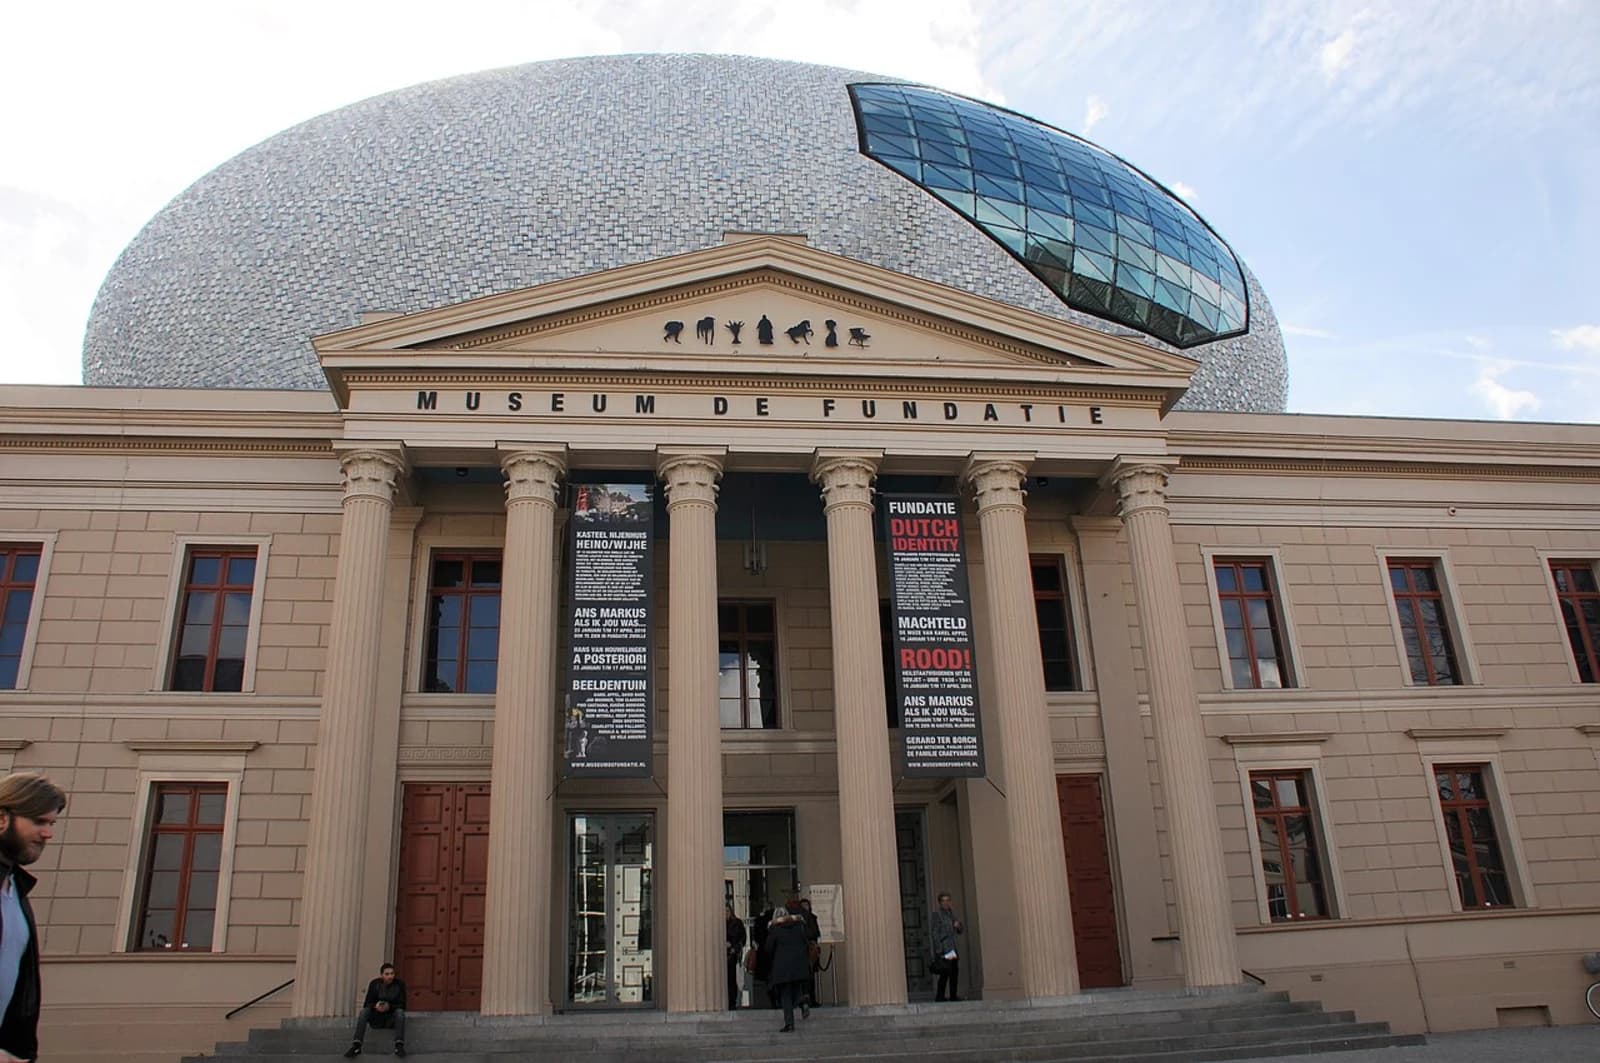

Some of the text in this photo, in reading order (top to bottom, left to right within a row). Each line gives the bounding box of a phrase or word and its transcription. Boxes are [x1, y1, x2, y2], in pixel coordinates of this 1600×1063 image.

[417, 391, 1103, 424] MUSEUM DE FUNDATIE
[889, 502, 956, 514] FUNDATIE
[891, 518, 959, 537] DUTCH
[576, 531, 608, 539] KASTEEL
[576, 539, 647, 550] HEINO/WIJHE
[892, 537, 958, 551] IDENTITY
[574, 607, 646, 618] ANS MARKUS
[574, 619, 590, 627] ALS
[592, 619, 600, 627] IK
[602, 619, 618, 627] JOU
[898, 616, 967, 629] MACHTELD
[573, 653, 647, 664] A POSTERIORI
[901, 648, 971, 669] ROOD!
[572, 679, 647, 690] BEELDENTUIN
[904, 695, 974, 706] ANS MARKUS
[904, 708, 920, 716] ALS
[921, 708, 930, 716] IK
[932, 708, 947, 716] JOU
[906, 736, 977, 744] GERARD TER BORCH
